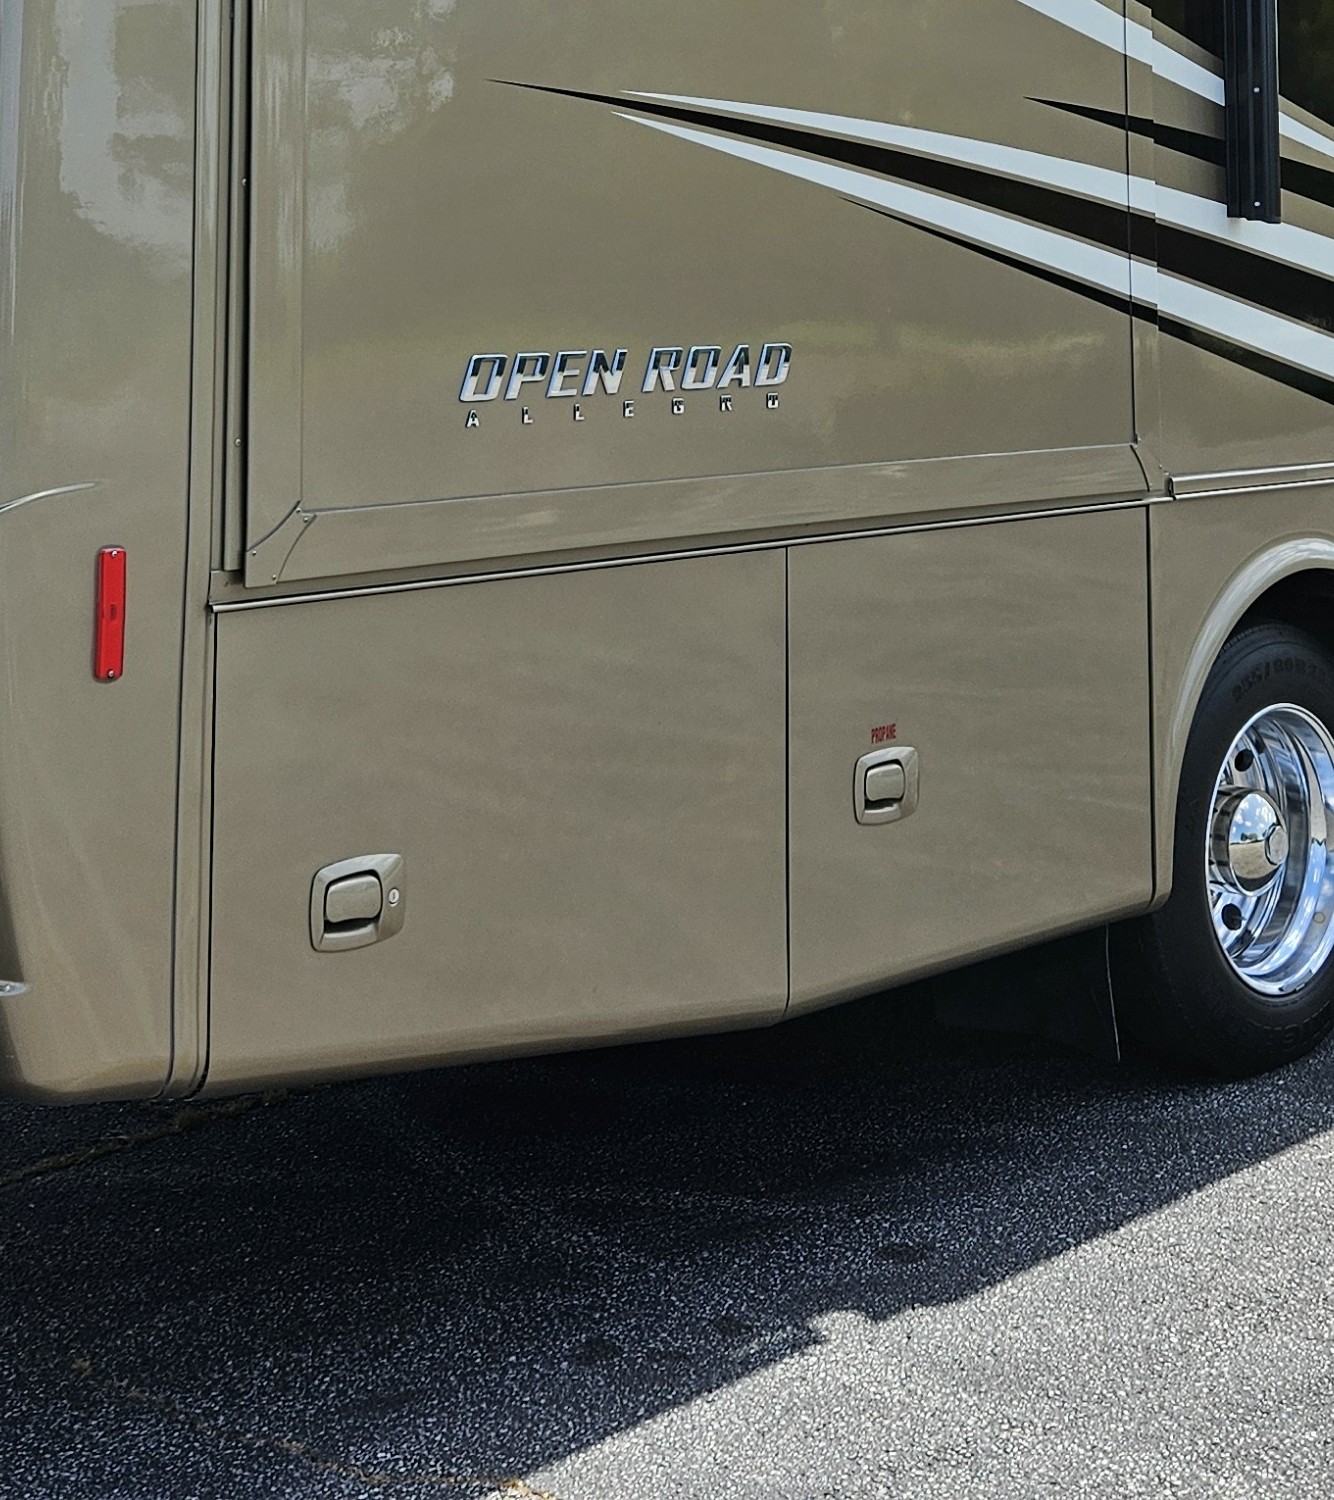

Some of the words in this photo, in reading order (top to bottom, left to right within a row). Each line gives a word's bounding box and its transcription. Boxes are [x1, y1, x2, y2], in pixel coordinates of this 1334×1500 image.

[459, 348, 629, 403] OPEN
[641, 342, 793, 393] ROAD
[465, 392, 780, 429] ALLEGRO
